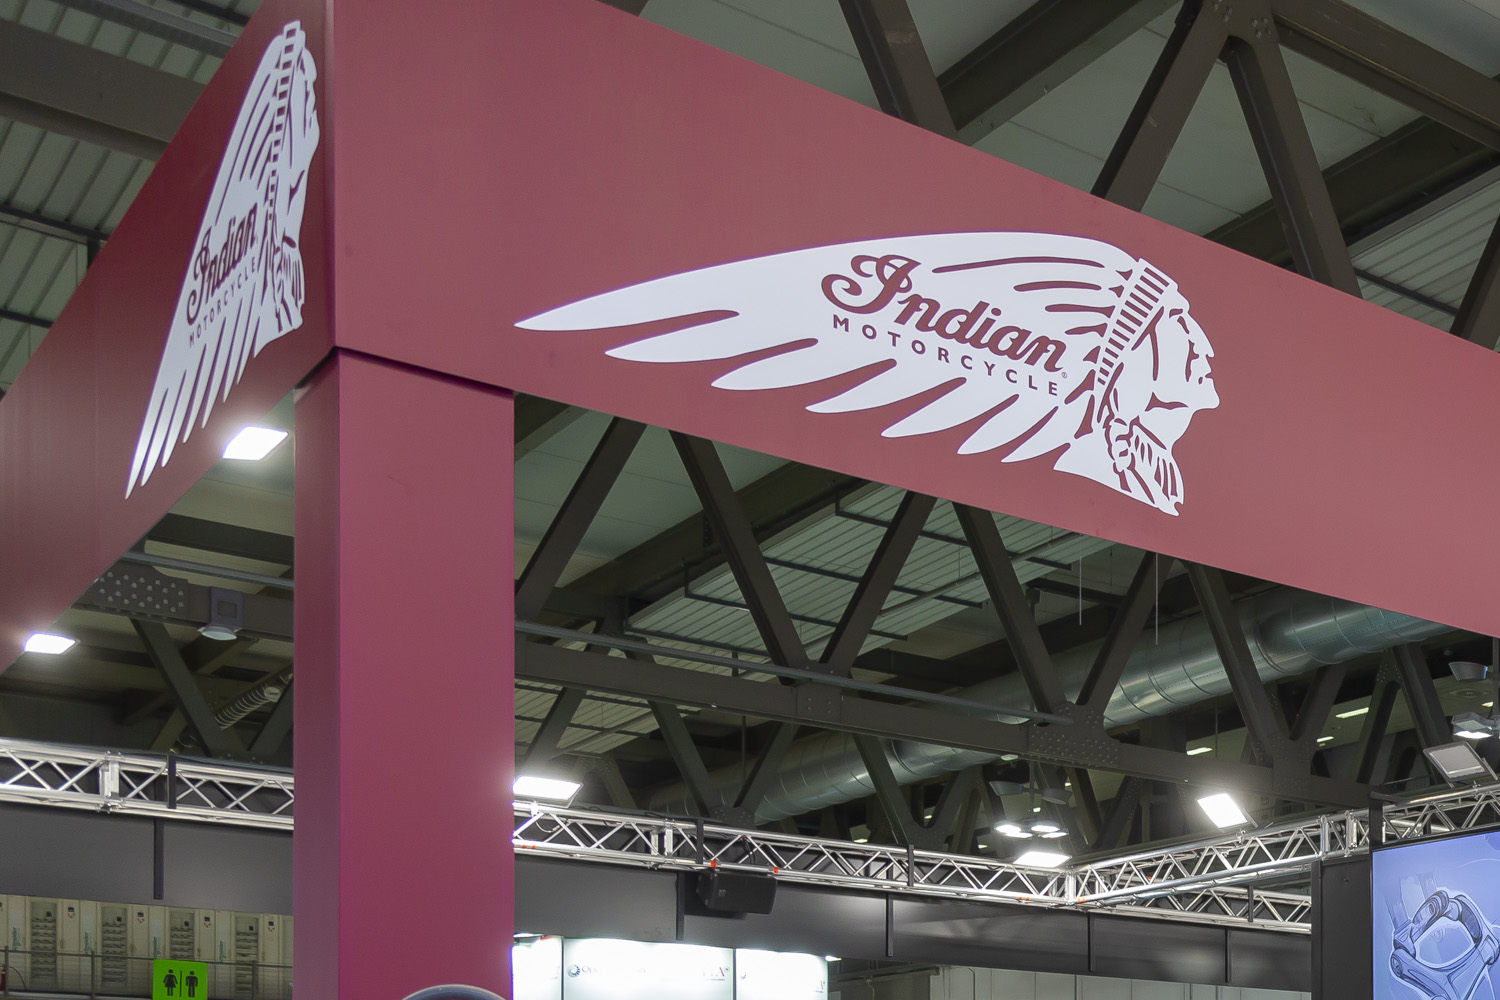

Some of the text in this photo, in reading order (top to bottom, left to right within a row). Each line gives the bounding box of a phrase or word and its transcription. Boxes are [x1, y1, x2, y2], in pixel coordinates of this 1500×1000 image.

[187, 202, 258, 325] Indian
[190, 257, 256, 348] MOTORCYCLE
[821, 254, 1067, 372] Indian
[833, 314, 1058, 396] MOTORCYCLE
